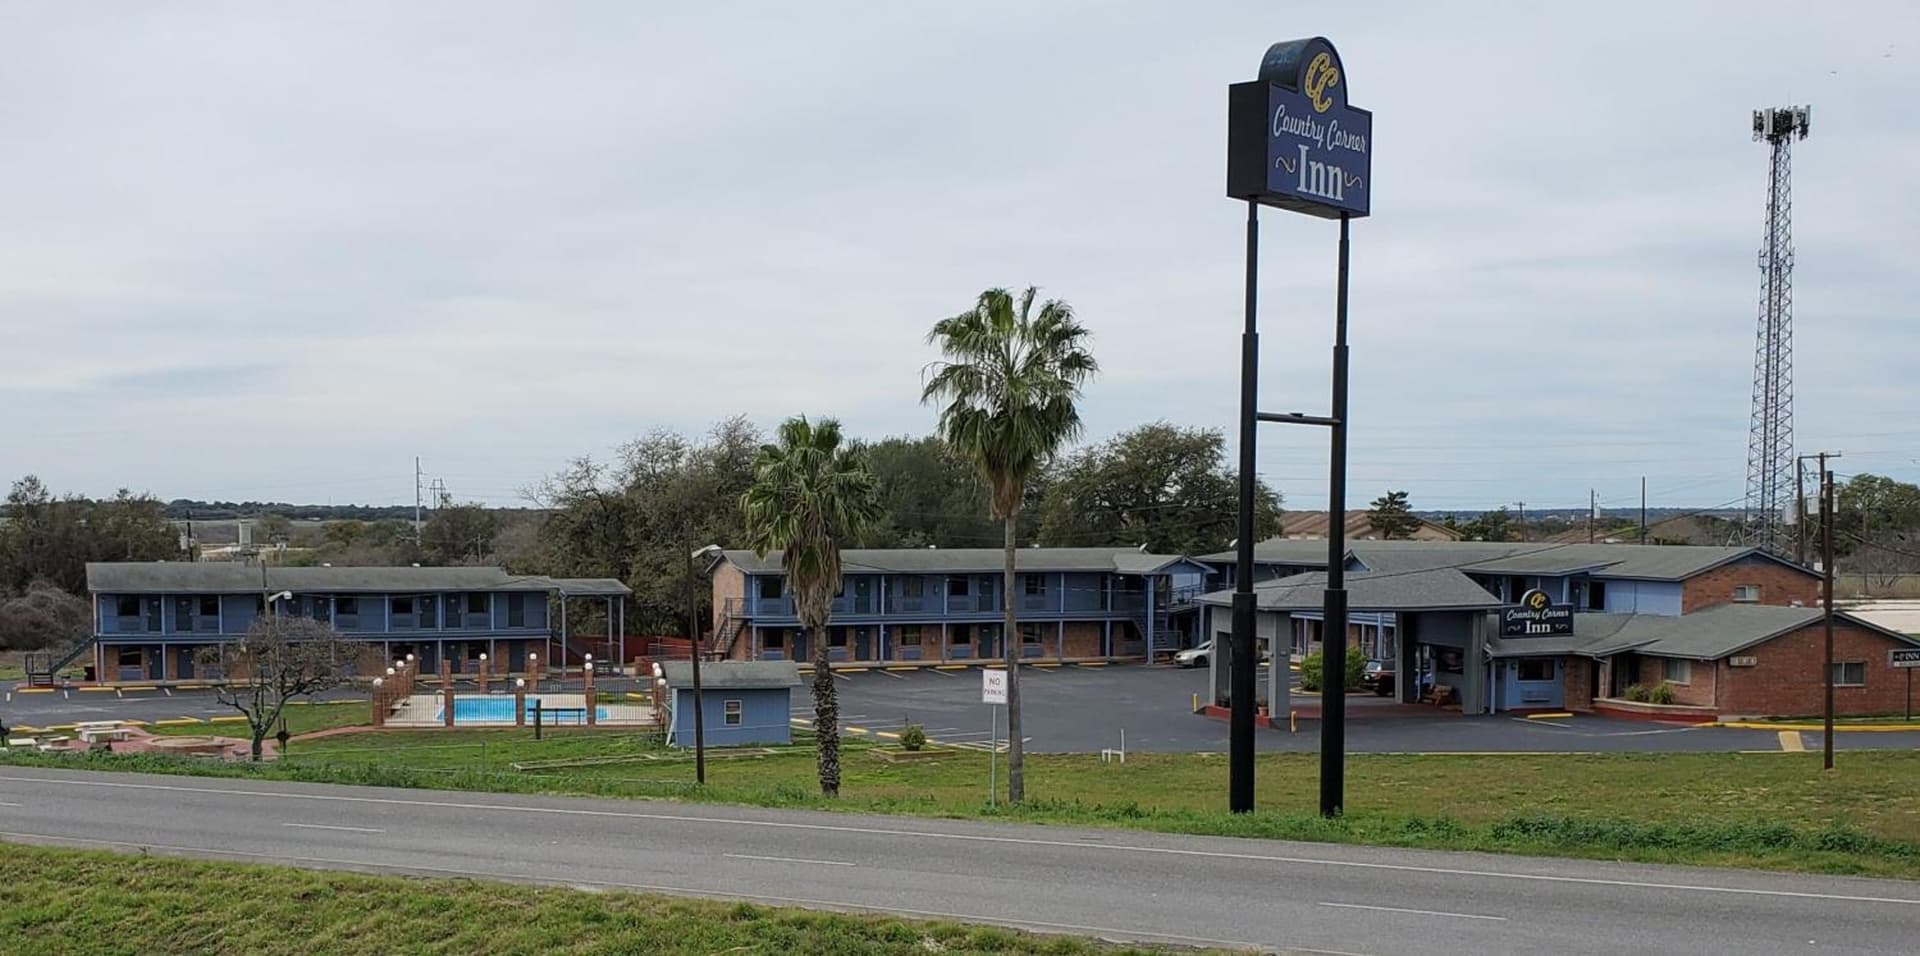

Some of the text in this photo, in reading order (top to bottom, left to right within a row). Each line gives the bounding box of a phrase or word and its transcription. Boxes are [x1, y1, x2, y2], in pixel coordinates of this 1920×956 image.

[1273, 104, 1366, 154] Country Corner
[1296, 143, 1344, 201] Inn
[1507, 609, 1568, 621] Country Corner
[1525, 621, 1550, 633] Inn
